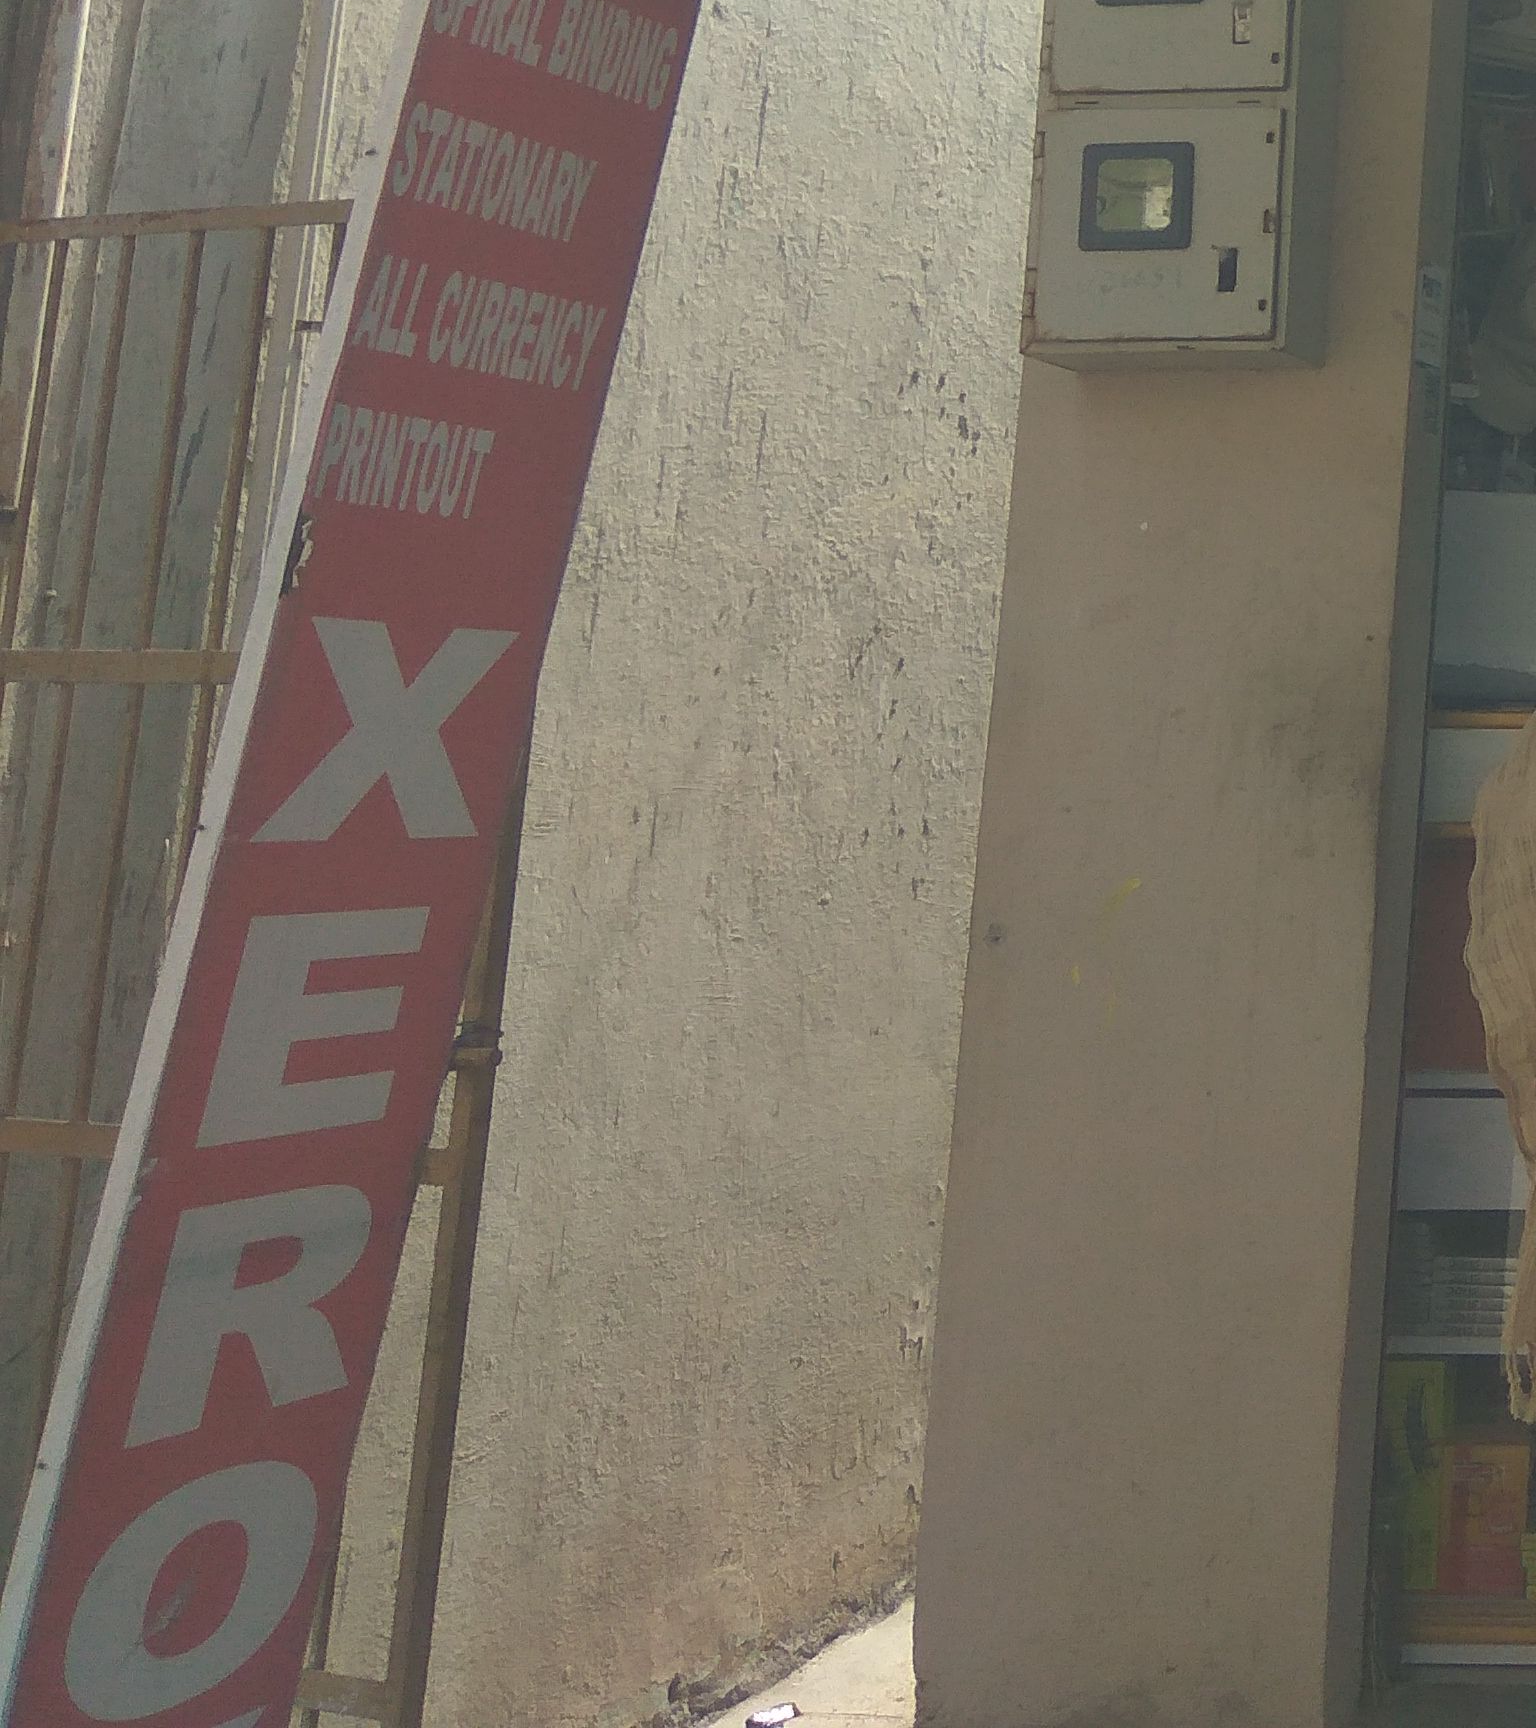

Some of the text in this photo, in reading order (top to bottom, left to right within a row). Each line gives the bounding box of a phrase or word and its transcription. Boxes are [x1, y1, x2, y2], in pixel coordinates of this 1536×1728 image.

[392, 101, 597, 243] STATIONARY
[355, 255, 604, 392] ALL CURRENCY
[315, 405, 493, 519] PRINTOUT
[62, 614, 520, 1728] XERO
